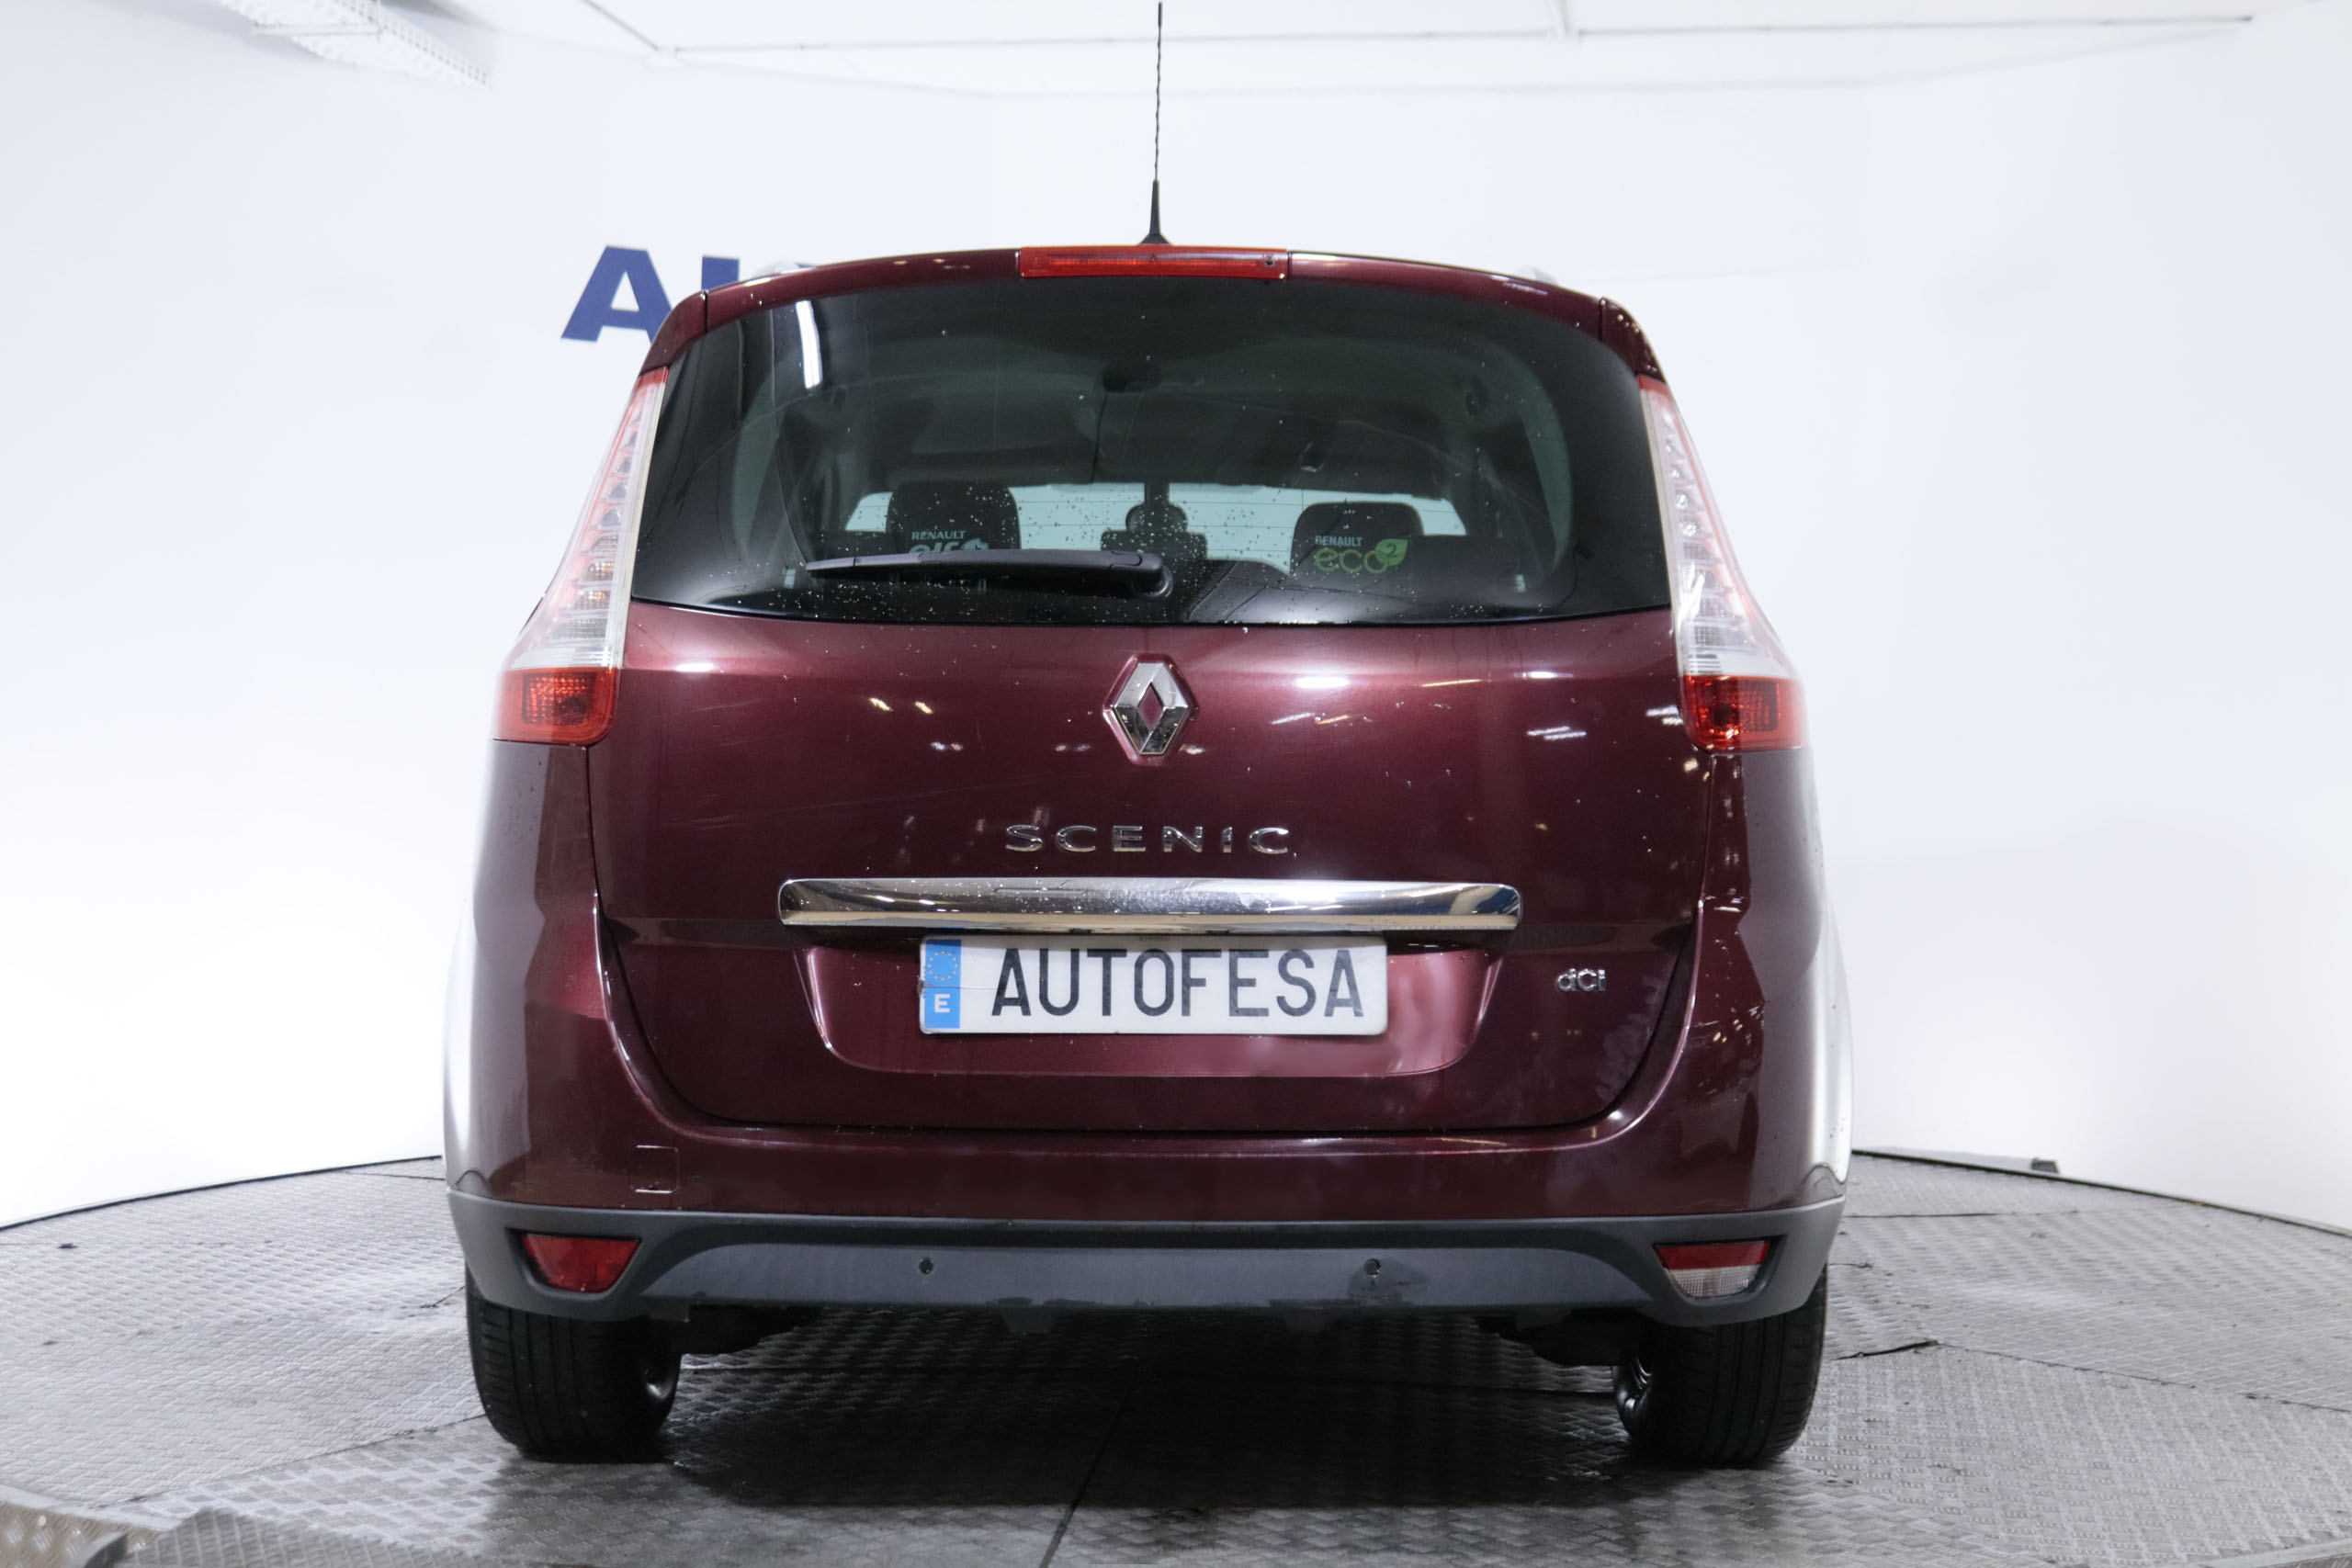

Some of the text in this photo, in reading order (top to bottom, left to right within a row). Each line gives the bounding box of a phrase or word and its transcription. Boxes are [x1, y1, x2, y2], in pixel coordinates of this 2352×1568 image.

[911, 530, 967, 540] RENAULT
[1315, 536, 1363, 547] RENAULT
[1005, 824, 1289, 854] SCENIC
[991, 948, 1364, 1017] AUTOFESA
[934, 994, 951, 1012] E
